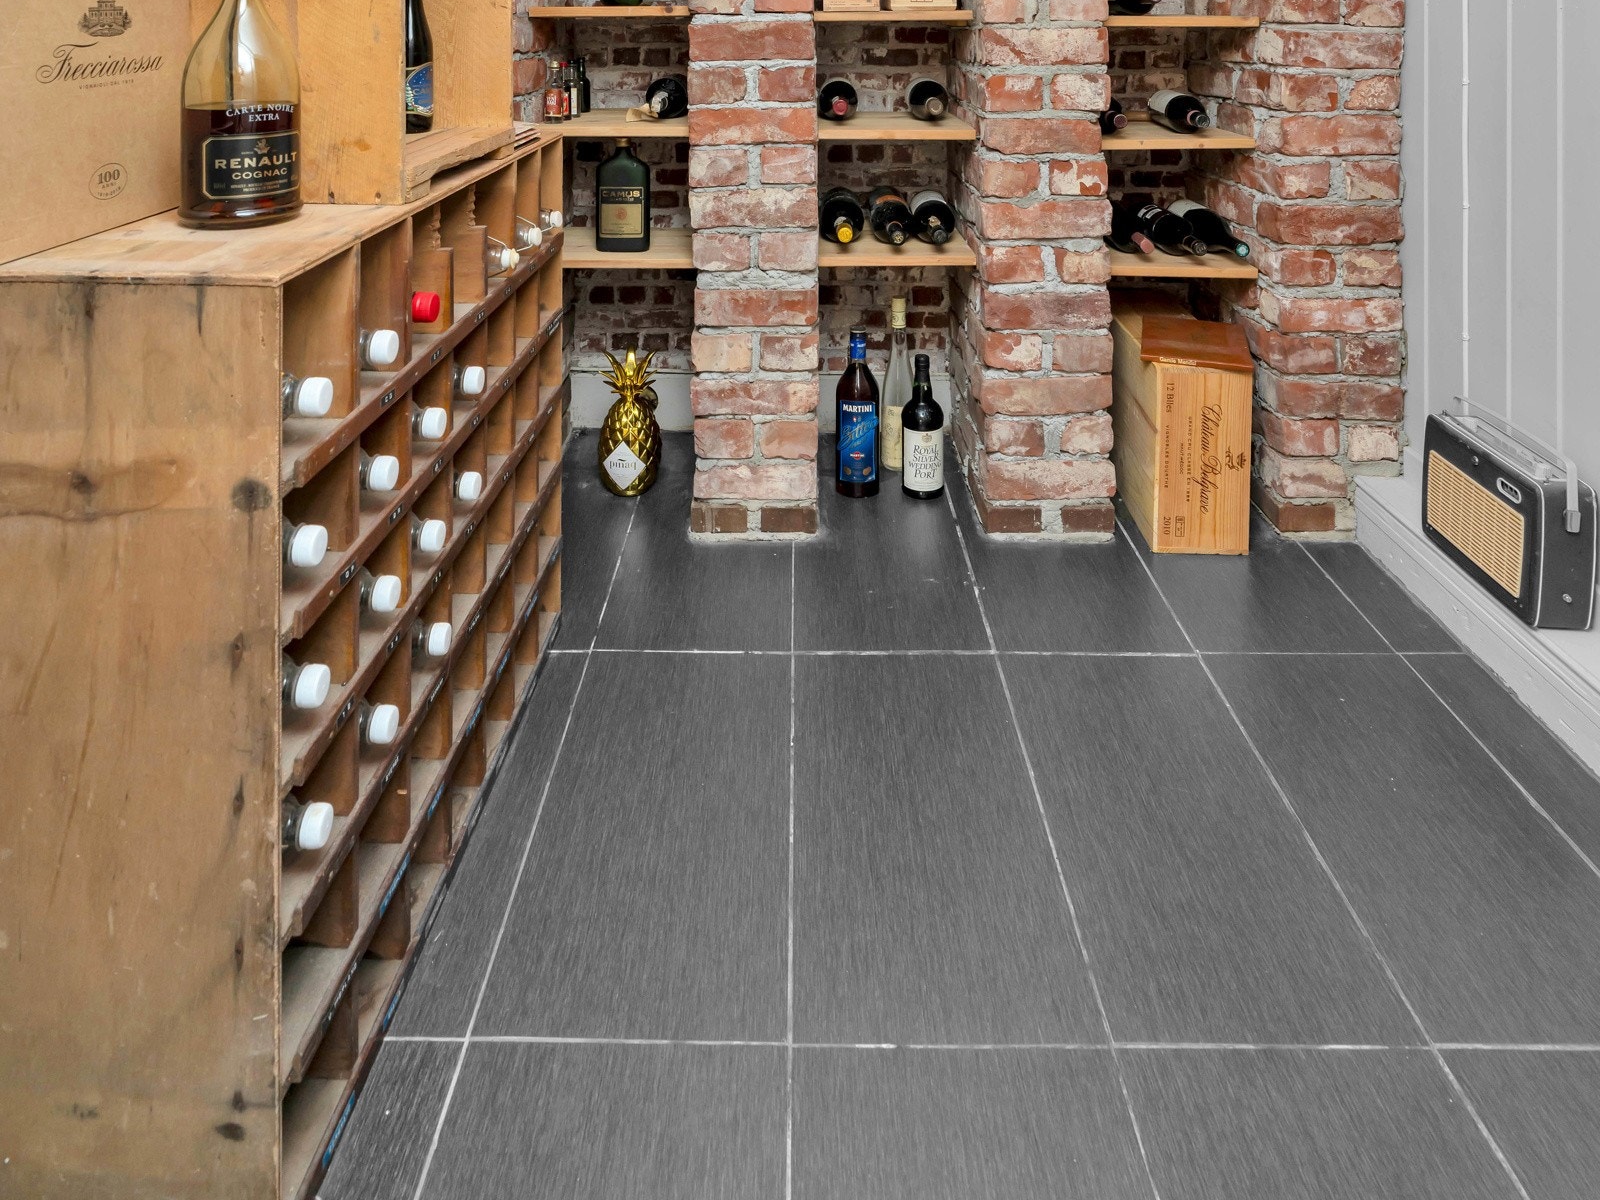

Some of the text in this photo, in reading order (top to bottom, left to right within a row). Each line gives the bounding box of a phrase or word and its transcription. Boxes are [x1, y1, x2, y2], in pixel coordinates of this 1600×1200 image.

[36, 41, 164, 84] Frecciarossa
[226, 104, 294, 117] CARTE NOIRE
[248, 113, 280, 122] EXTRA
[214, 151, 297, 169] RENAULT
[97, 169, 120, 185] 100
[231, 167, 288, 180] COGNAC
[1166, 383, 1174, 391] 12
[842, 403, 872, 413] MARTINI
[913, 444, 938, 454] ROYAL
[912, 453, 940, 462] SILVER
[908, 461, 942, 471] WEDDING
[914, 468, 936, 479] PORT
[1192, 455, 1222, 515] Belgrave
[1163, 517, 1171, 535] 2010
